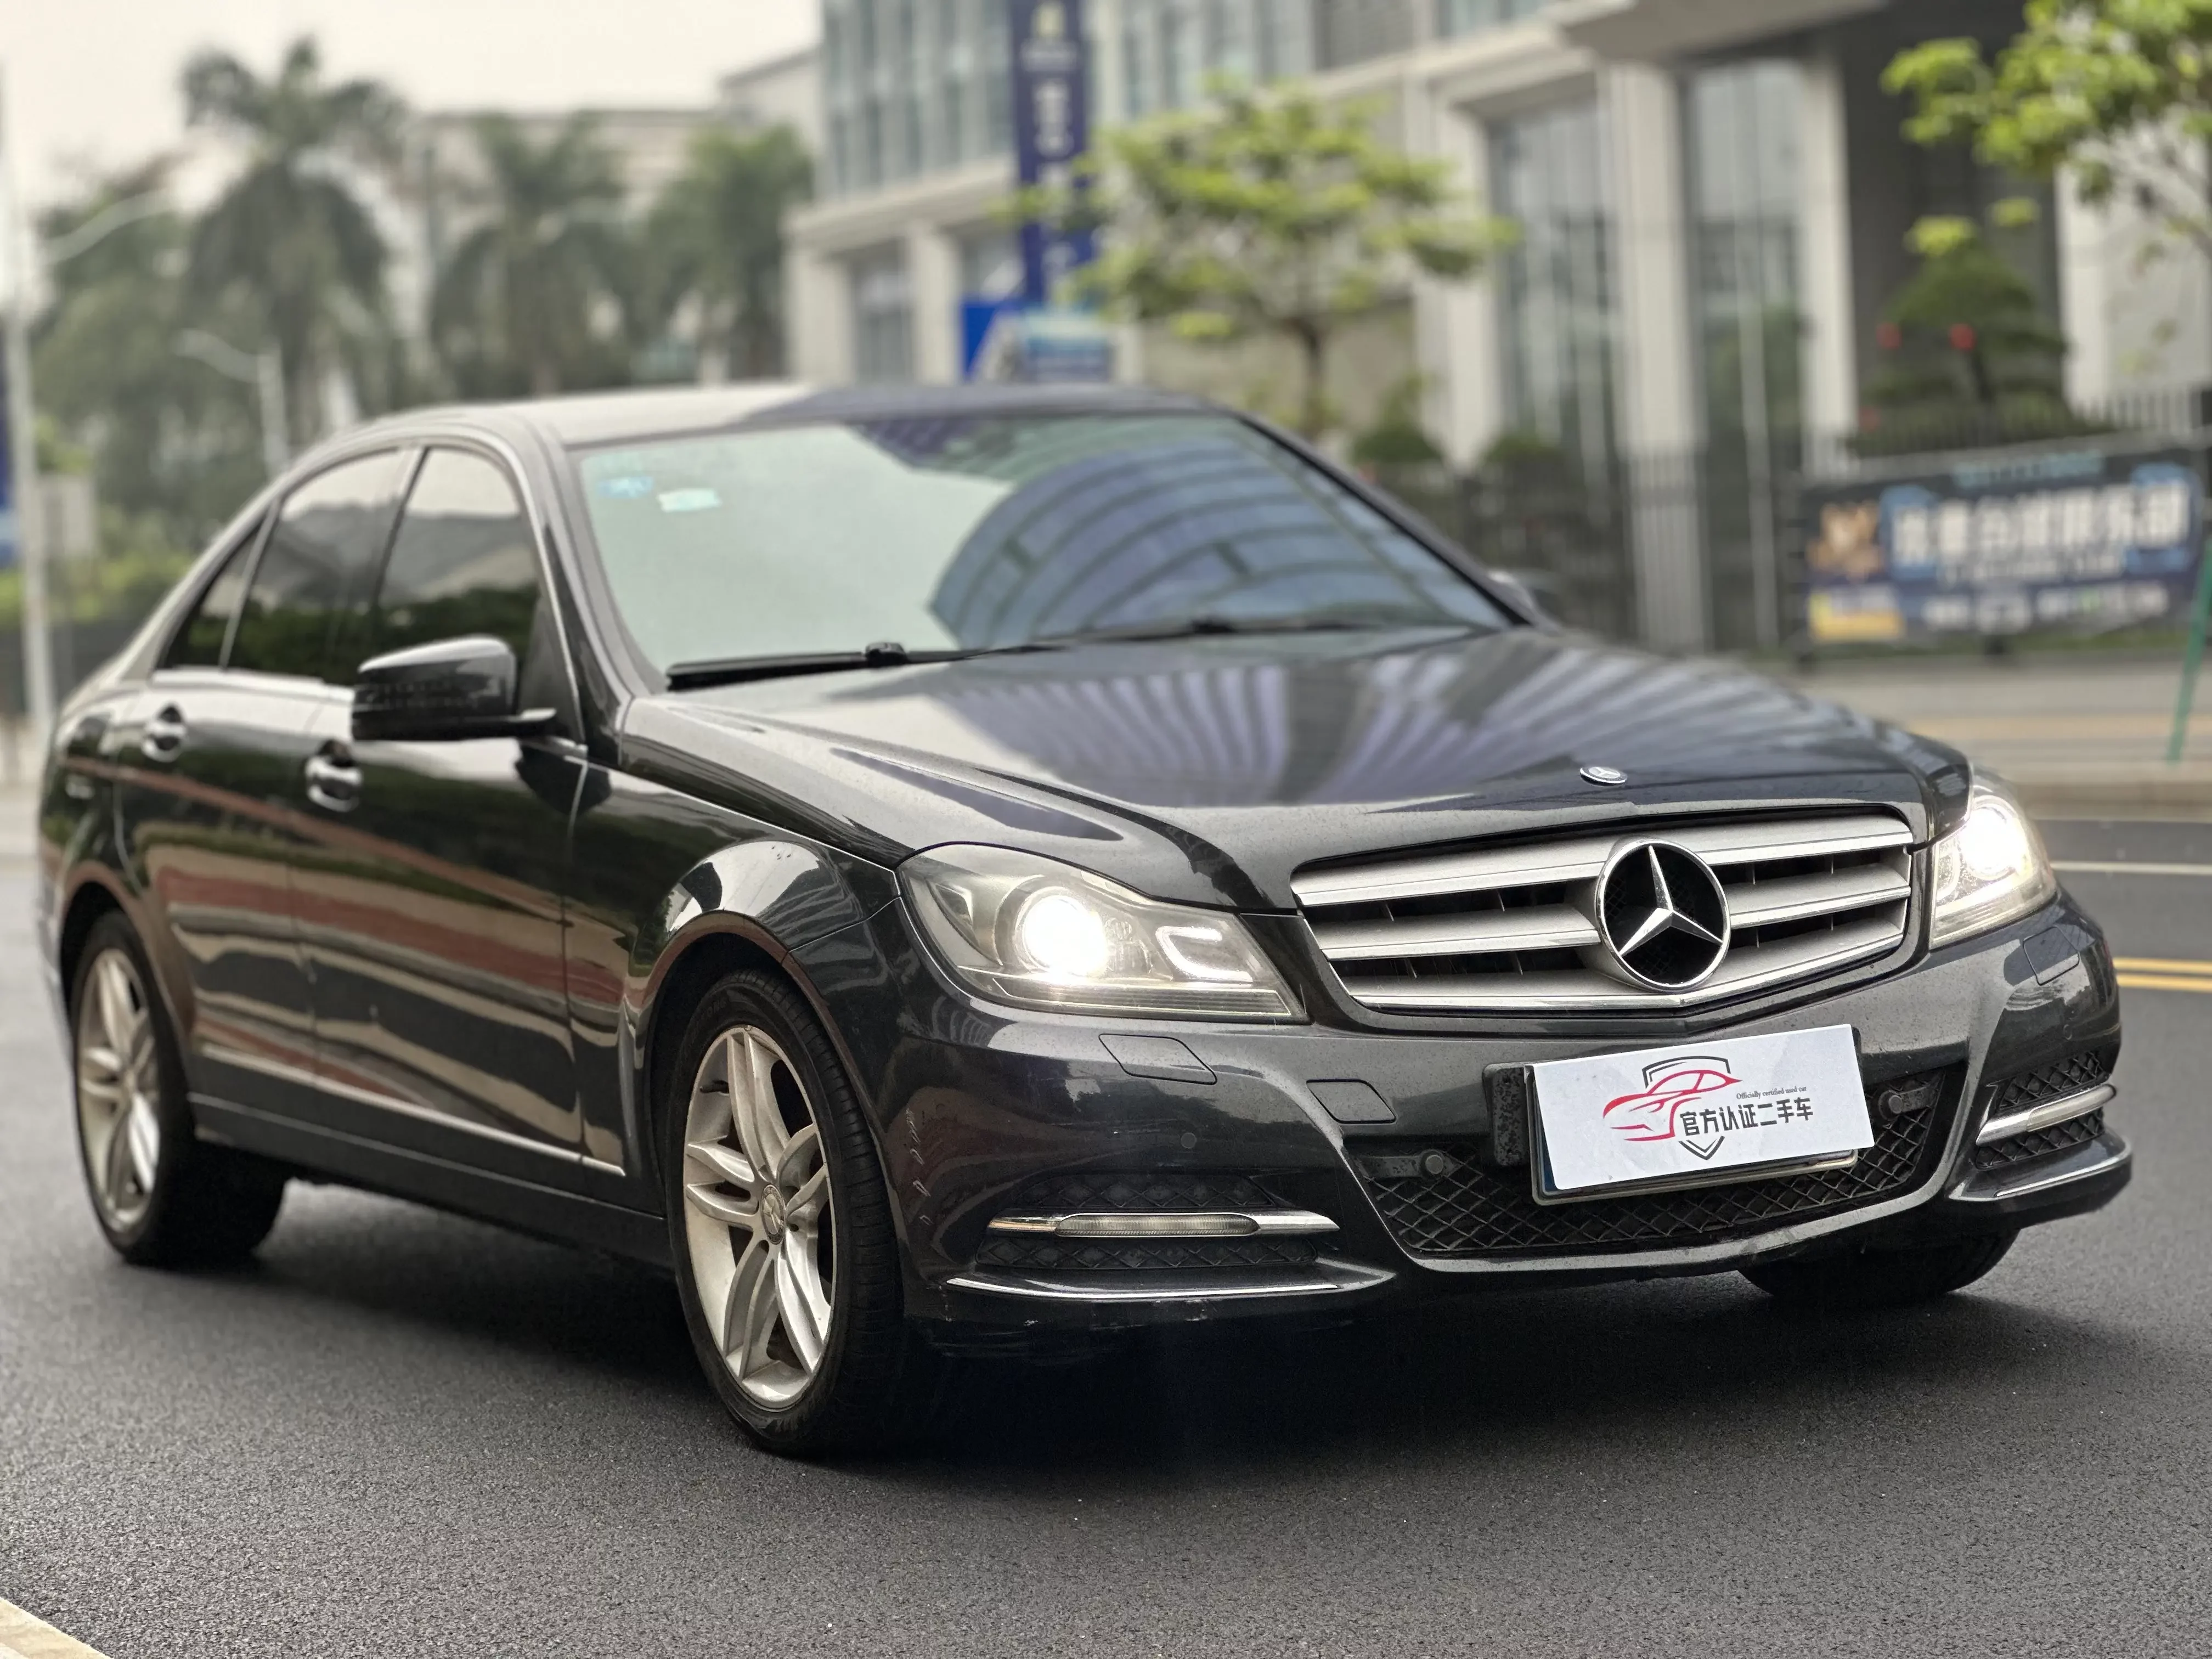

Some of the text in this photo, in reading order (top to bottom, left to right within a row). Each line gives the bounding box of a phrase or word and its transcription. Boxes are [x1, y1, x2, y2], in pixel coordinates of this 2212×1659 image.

[1736, 1091, 1761, 1099] Officially
[1680, 1097, 1814, 1136] 官方认证二手车
